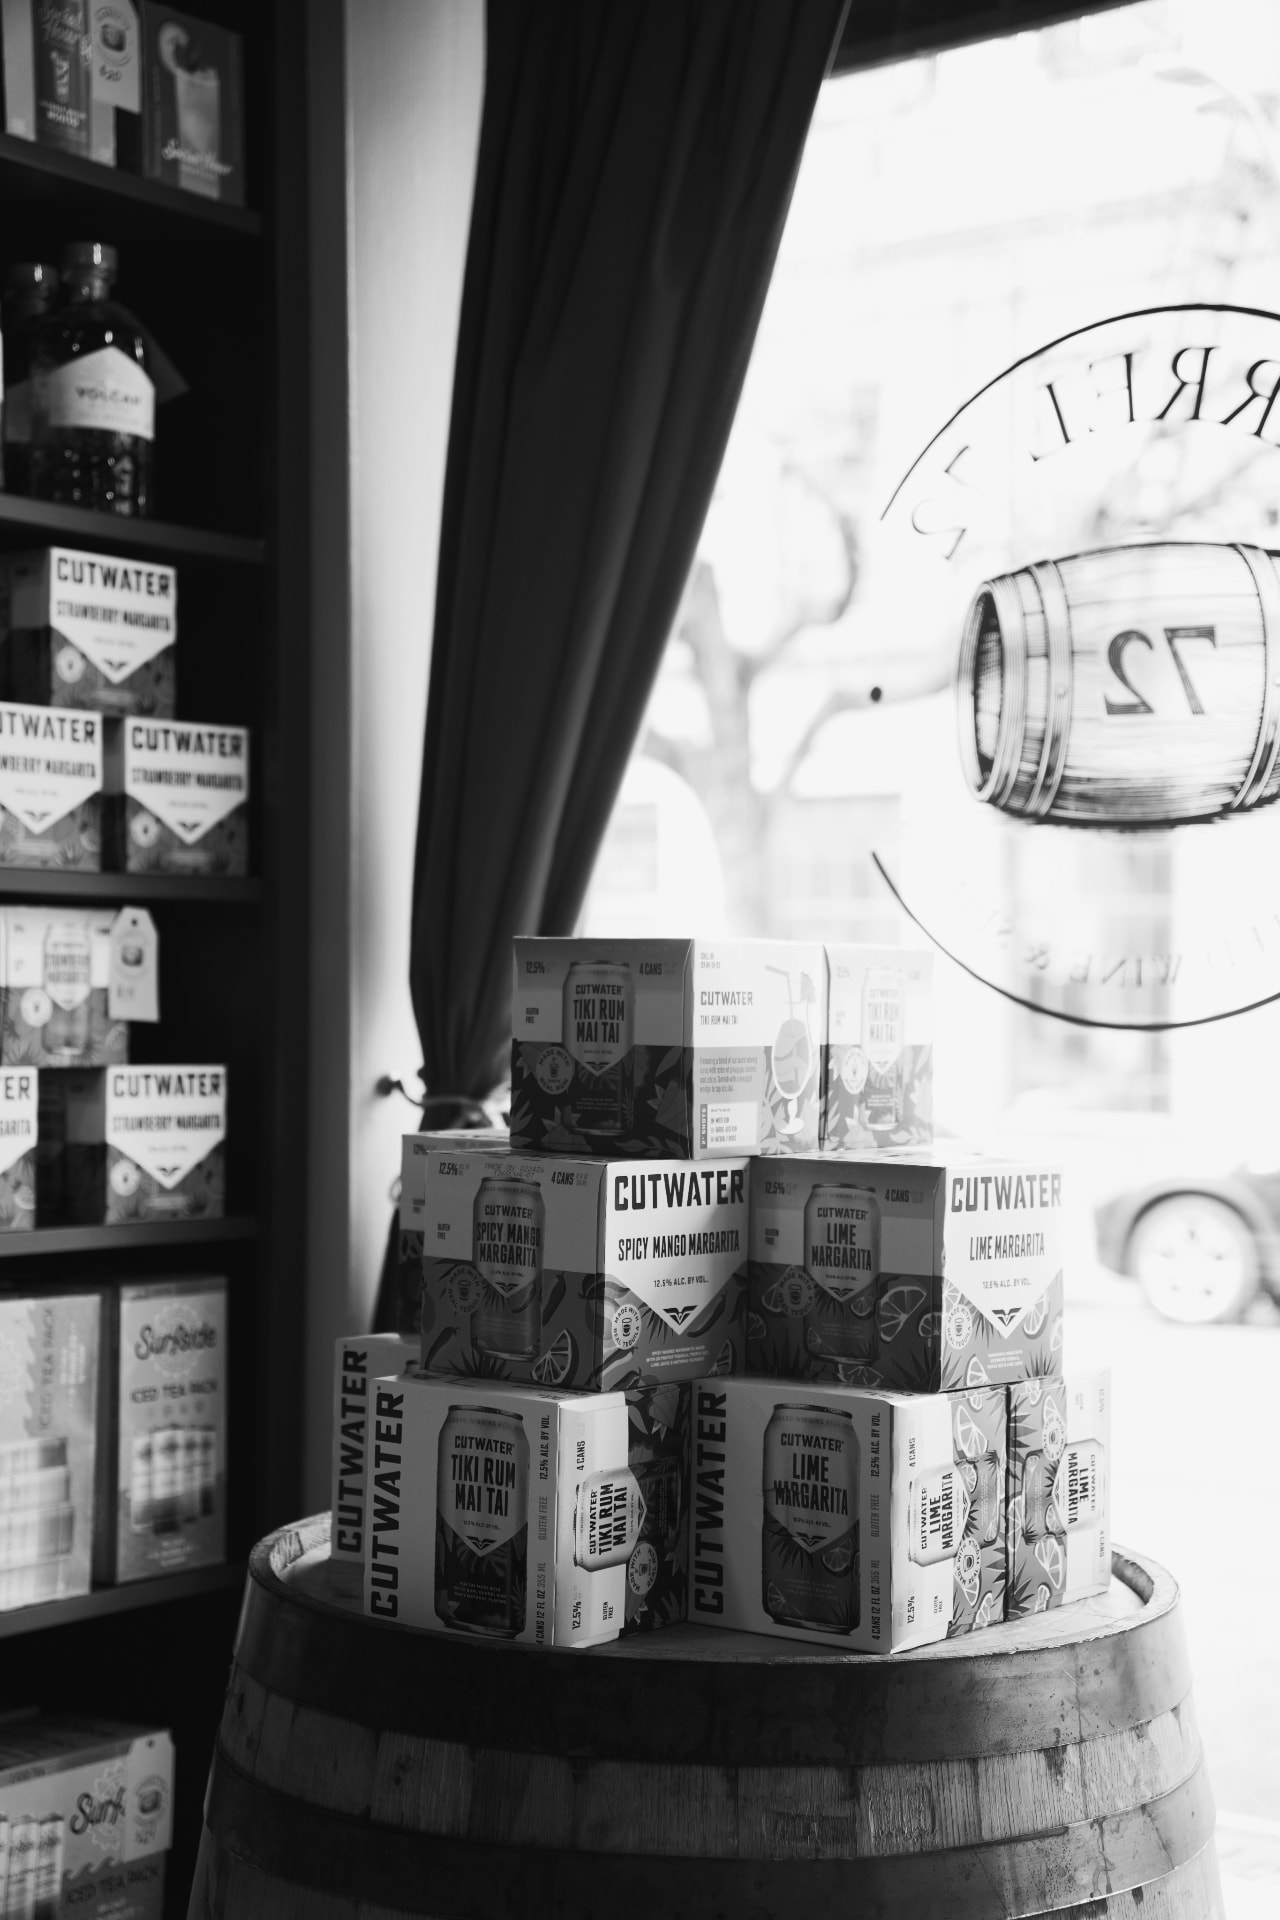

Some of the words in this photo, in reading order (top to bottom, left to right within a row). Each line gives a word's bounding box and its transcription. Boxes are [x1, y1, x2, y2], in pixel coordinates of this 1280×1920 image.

[57, 557, 171, 597] CUTWATER
[57, 601, 120, 623] STRAWBERRY
[123, 609, 171, 631] MARGARITA
[0, 711, 96, 746] TWATER
[131, 726, 244, 759] CUTWATER
[45, 759, 97, 779] MARGARITA
[132, 768, 193, 787] STRAWBERRY
[196, 772, 243, 792] MARGARITA
[644, 962, 663, 976] CANS
[575, 984, 623, 996] CUTWATER
[700, 991, 753, 1006] CUTWATER
[573, 999, 595, 1020] TIKI
[599, 999, 625, 1021] RUM
[576, 1021, 598, 1043] MAI
[602, 1022, 620, 1044] TAI
[0, 1076, 31, 1101] ER
[113, 1073, 221, 1098] CUTWATER
[112, 1115, 172, 1133] STRAWBERRY
[176, 1113, 220, 1131] MARGARITA
[439, 1162, 458, 1175] 12.5%
[551, 1171, 556, 1185] 4
[556, 1171, 575, 1186] CANS
[614, 1168, 745, 1212] CUTWATER
[765, 1180, 785, 1195] 12.5%
[885, 1188, 890, 1202] 4
[891, 1188, 910, 1203] CANS
[951, 1173, 1063, 1213] CUTWATER
[484, 1204, 534, 1220] CUTWATER
[817, 1207, 868, 1221] CUTWATER
[476, 1222, 503, 1242] SPICY
[507, 1223, 540, 1248] MANGO
[618, 1236, 648, 1262] SPICY
[652, 1233, 687, 1259] MANGO
[688, 1229, 740, 1256] MARGARITA
[827, 1222, 857, 1246] LIME
[479, 1243, 536, 1268] MARGARITA
[969, 1235, 992, 1261] LIME
[994, 1232, 1045, 1260] MARGARITA
[811, 1245, 872, 1272] MARGARITA
[653, 1278, 673, 1288] 12.5%
[673, 1276, 687, 1287] ALC.
[687, 1276, 695, 1285] BY
[614, 1306, 628, 1324] MADE
[628, 1307, 639, 1322] WITH
[613, 1327, 622, 1346] REAL
[540, 1414, 550, 1429] VOL.
[871, 1412, 881, 1427] VOL.
[540, 1432, 549, 1441] BY
[780, 1432, 844, 1453] CUTWATER
[871, 1428, 880, 1438] BY
[337, 1349, 369, 1553] CUTWATER
[454, 1435, 514, 1456] CUTWATER
[539, 1443, 549, 1458] ALC.
[576, 1440, 586, 1464] CANS
[871, 1440, 880, 1455] ALC.
[908, 1437, 916, 1460] CANS
[451, 1454, 479, 1483] TIKI
[483, 1457, 516, 1489] RUM
[539, 1459, 549, 1480] 12.5%
[792, 1452, 829, 1483] LIME
[870, 1456, 880, 1478] 12.5%
[1067, 1451, 1079, 1526] MARGARITA
[1078, 1466, 1090, 1504] LIME
[370, 1391, 404, 1618] CUTWATER
[455, 1483, 482, 1513] MAI
[487, 1487, 508, 1517] TAI
[538, 1496, 548, 1514] FREE
[599, 1483, 614, 1519] RUM
[613, 1486, 627, 1513] TAI
[694, 1391, 727, 1615] CUTWATER
[773, 1479, 848, 1516] MARGARITA
[870, 1494, 880, 1511] FREE
[589, 1489, 598, 1555] CUTWATER
[920, 1486, 928, 1551] CUTWATER
[929, 1495, 942, 1535] LIME
[941, 1472, 953, 1550] MARGARITA
[538, 1515, 548, 1542] GLUTEN
[613, 1516, 627, 1545] MAI
[870, 1513, 880, 1538] GLUTEN
[598, 1521, 613, 1556] TIKI
[537, 1562, 547, 1572] ML
[630, 1548, 641, 1569] WITH
[537, 1573, 547, 1588] 355
[630, 1571, 640, 1592] MADE
[871, 1571, 880, 1584] 355
[536, 1589, 546, 1600] OZ
[871, 1585, 880, 1595] OZ
[871, 1597, 880, 1605] FL
[536, 1601, 546, 1610] FL
[536, 1610, 546, 1619] 12
[571, 1601, 582, 1630] 12.5%
[871, 1606, 881, 1615] 12
[907, 1595, 915, 1624] 12.5%
[536, 1620, 546, 1639] CANS
[871, 1616, 881, 1634] CANS
